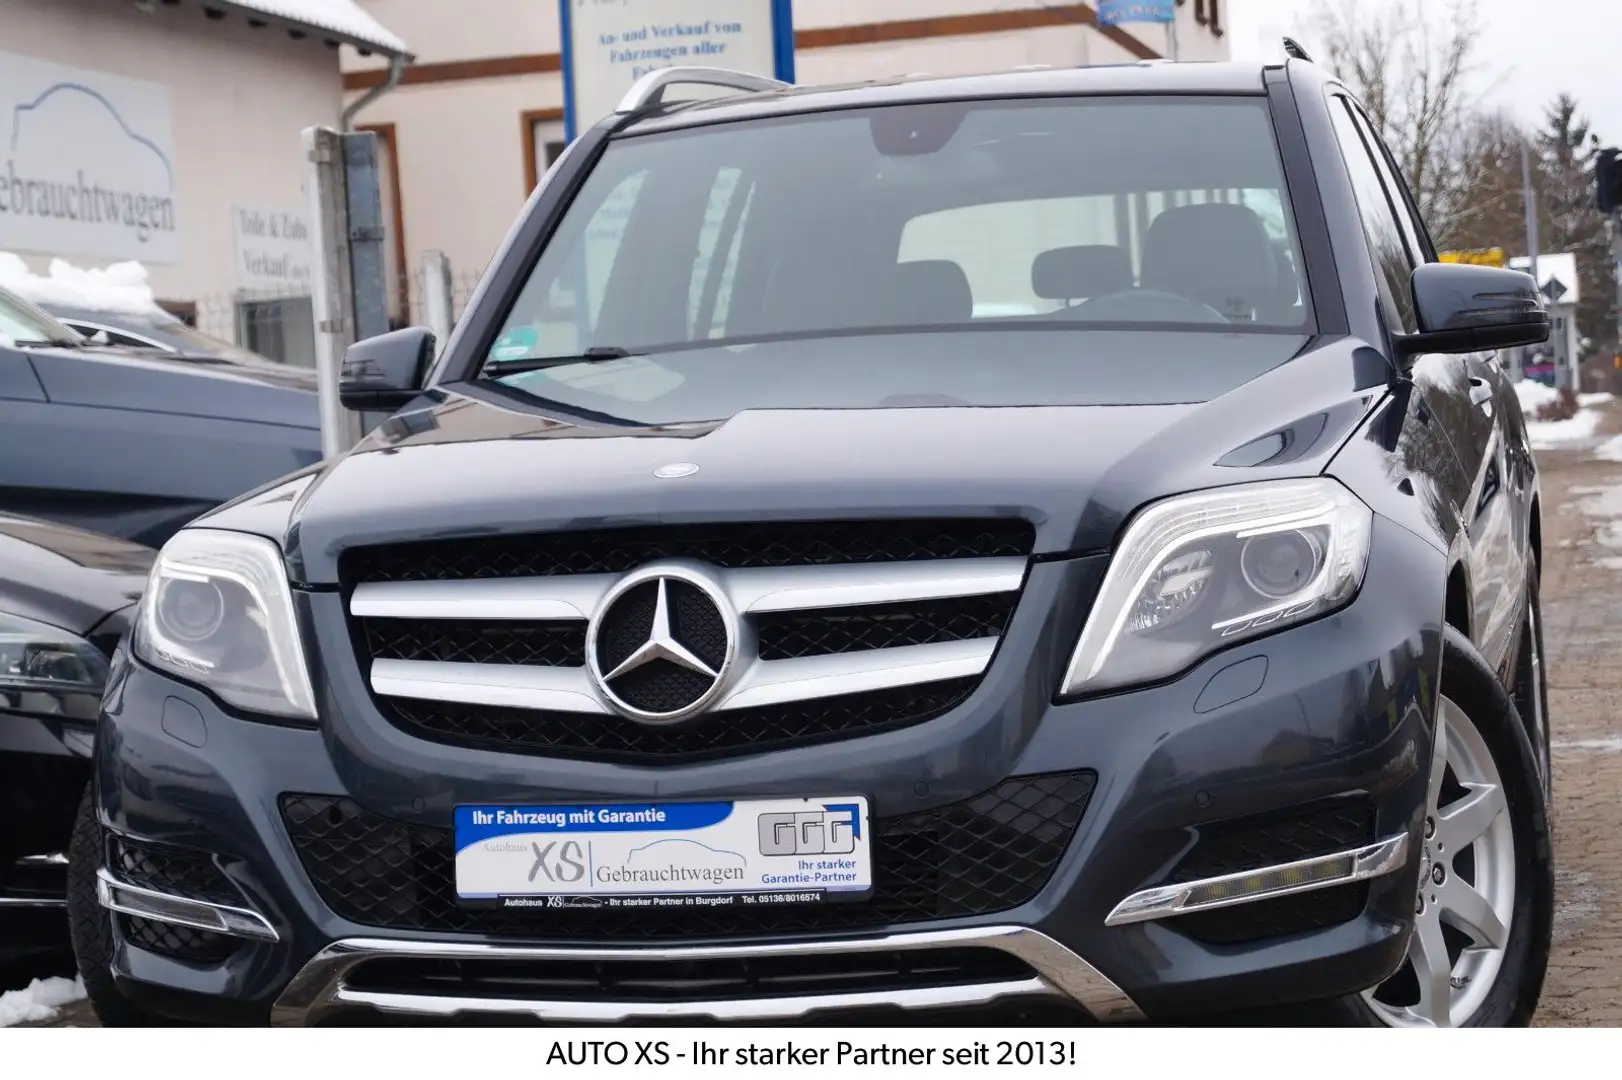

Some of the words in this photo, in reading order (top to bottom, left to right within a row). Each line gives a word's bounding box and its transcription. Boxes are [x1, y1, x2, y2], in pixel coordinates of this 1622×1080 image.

[623, 27, 646, 42] und
[652, 21, 710, 38] Verkauf
[715, 21, 742, 34] von
[610, 46, 688, 63] Fahrzeugen
[692, 41, 727, 55] aller
[473, 810, 492, 825] Ihr
[497, 810, 565, 827] Fahrzeug
[569, 809, 595, 824] mit
[598, 808, 666, 823] Garantie
[482, 841, 528, 853] Autohaus
[528, 841, 585, 883] XS
[597, 865, 744, 885] Gebrauchtwagen
[798, 861, 813, 871] Ihr
[816, 858, 857, 870] starker
[761, 872, 857, 885] Garantie-Partner
[504, 898, 543, 907] Autohaus
[547, 896, 563, 908] XS
[609, 898, 621, 906] Ihr
[622, 898, 651, 906] starker
[653, 897, 684, 906] Partner
[685, 897, 694, 905] in
[695, 896, 733, 906] Burgdorf
[742, 895, 757, 904] Tel.
